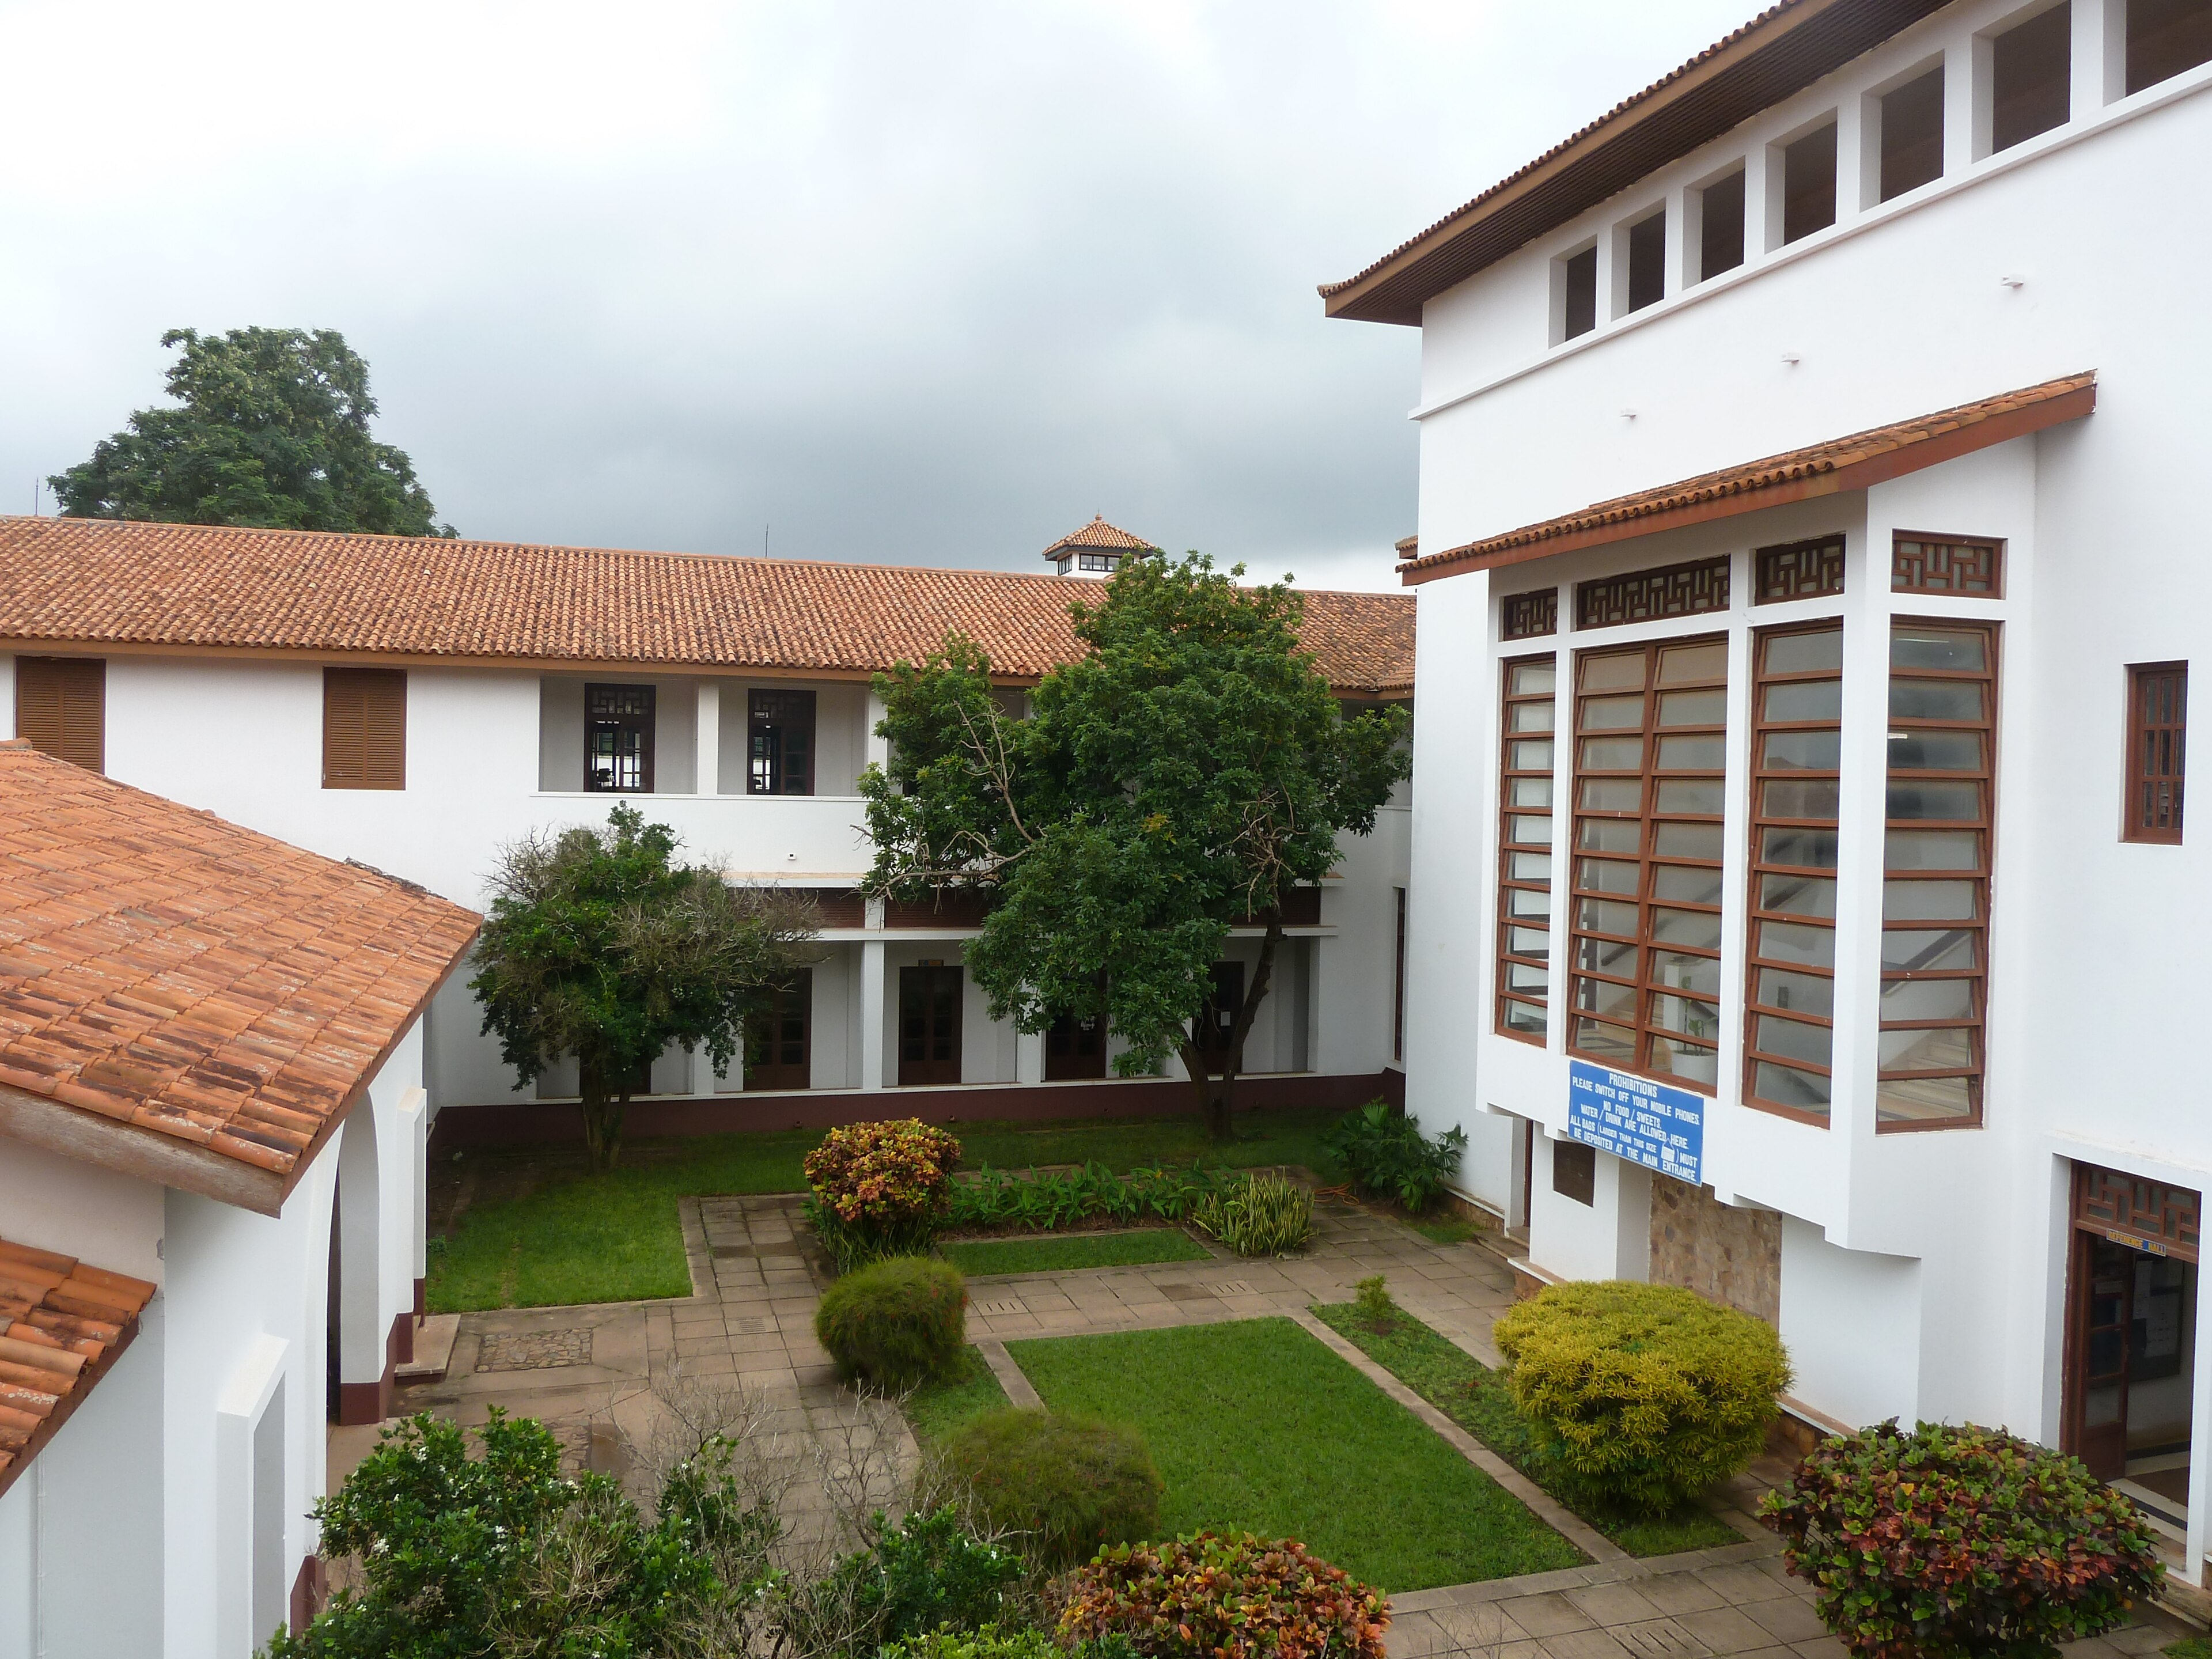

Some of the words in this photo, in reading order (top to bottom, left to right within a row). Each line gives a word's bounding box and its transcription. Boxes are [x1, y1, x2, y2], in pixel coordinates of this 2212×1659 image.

[1573, 1076, 1593, 1092] PLEASE
[1595, 1084, 1615, 1099] SWITCH
[1619, 1090, 1629, 1103] OFF
[1633, 1095, 1647, 1109] YOUR
[1650, 1100, 1672, 1116] MOBILE
[1675, 1108, 1700, 1125] PHONES.
[1609, 1073, 1657, 1097] PROHIBITIONS
[1581, 1104, 1598, 1118] WATER
[1605, 1112, 1622, 1127] DRINK
[1624, 1119, 1637, 1131] ARE
[1639, 1124, 1666, 1142] ALLOWED
[1671, 1134, 1689, 1149] HERE.
[1604, 1100, 1611, 1112] NO
[1615, 1104, 1629, 1118] FOOD
[1637, 1111, 1661, 1129] SWEETS.
[1570, 1115, 1581, 1127] ALL
[1582, 1119, 1595, 1131] BAGS
[1619, 1132, 1631, 1144] THAN
[1634, 1138, 1644, 1149] THIS
[1646, 1142, 1657, 1153] SIZE
[1680, 1152, 1698, 1168] MUST
[1574, 1127, 1582, 1139] BE
[1584, 1131, 1612, 1151] DEPOSITED
[1616, 1145, 1623, 1154] AT
[1627, 1147, 1638, 1160] THE
[1643, 1152, 1658, 1167] MAIN
[1662, 1160, 1696, 1181] ENTRANCE.
